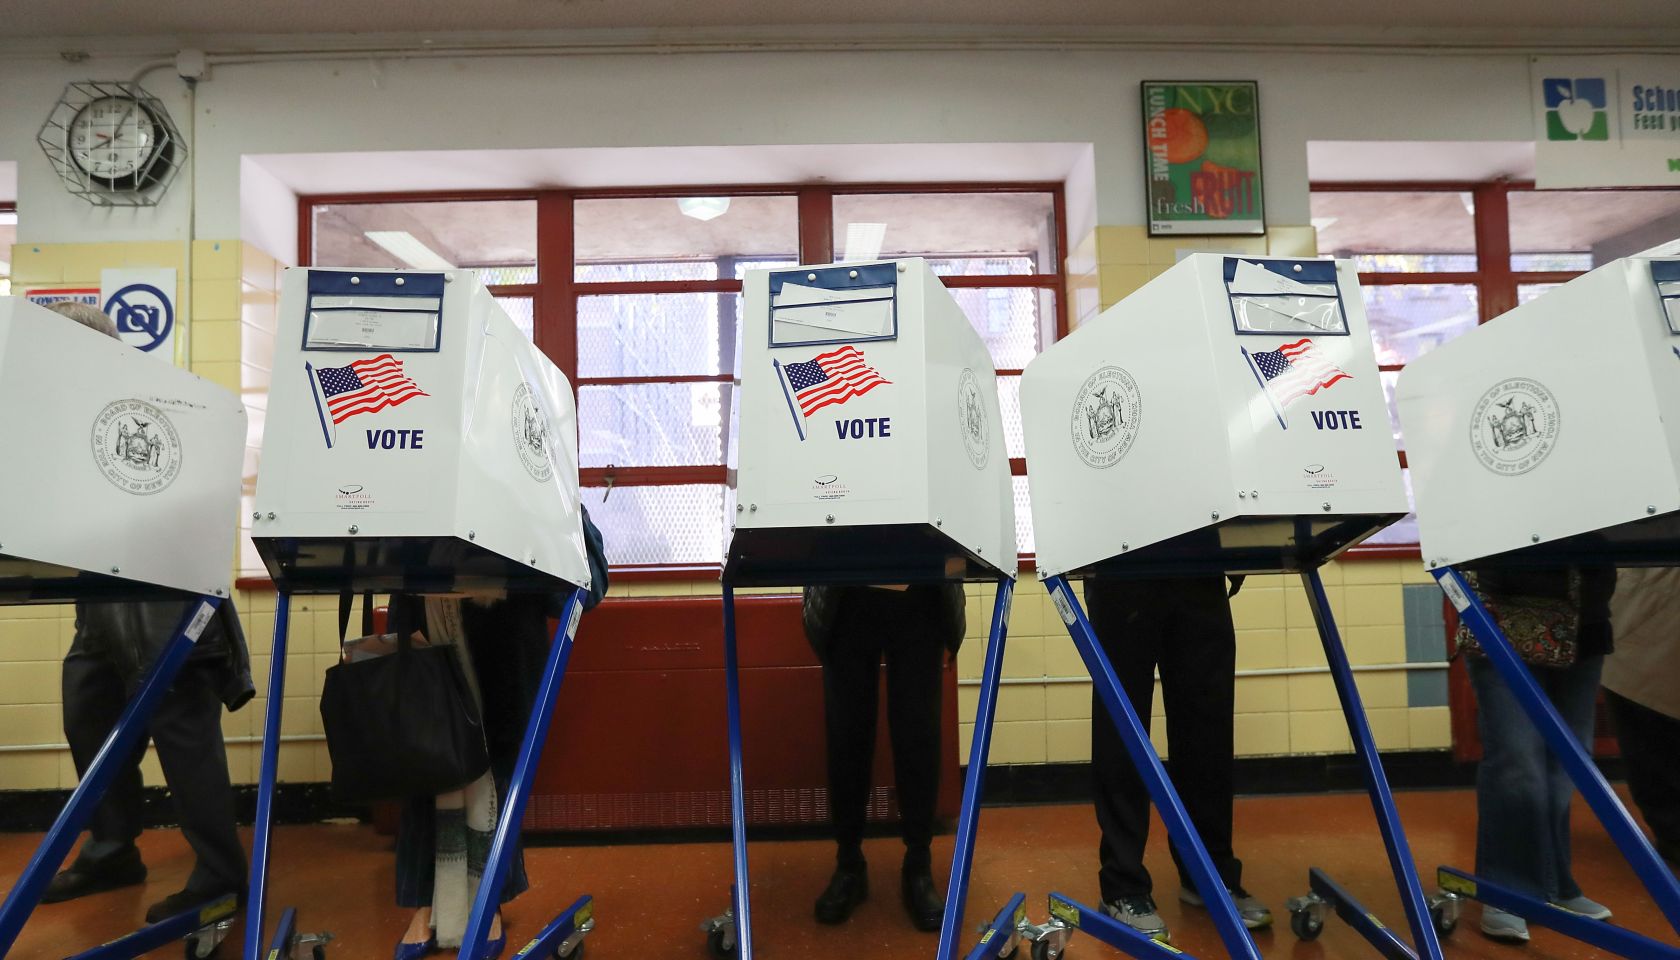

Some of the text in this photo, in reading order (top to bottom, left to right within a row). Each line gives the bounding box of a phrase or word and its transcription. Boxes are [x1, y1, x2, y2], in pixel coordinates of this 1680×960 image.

[1178, 87, 1250, 114] NYC
[1634, 113, 1664, 130] Feed
[1150, 87, 1169, 181] LUNCH TIME
[1157, 196, 1205, 214] fresh
[835, 417, 891, 440] VOTE
[1311, 410, 1362, 430] VOTE
[366, 429, 423, 450] VOTE
